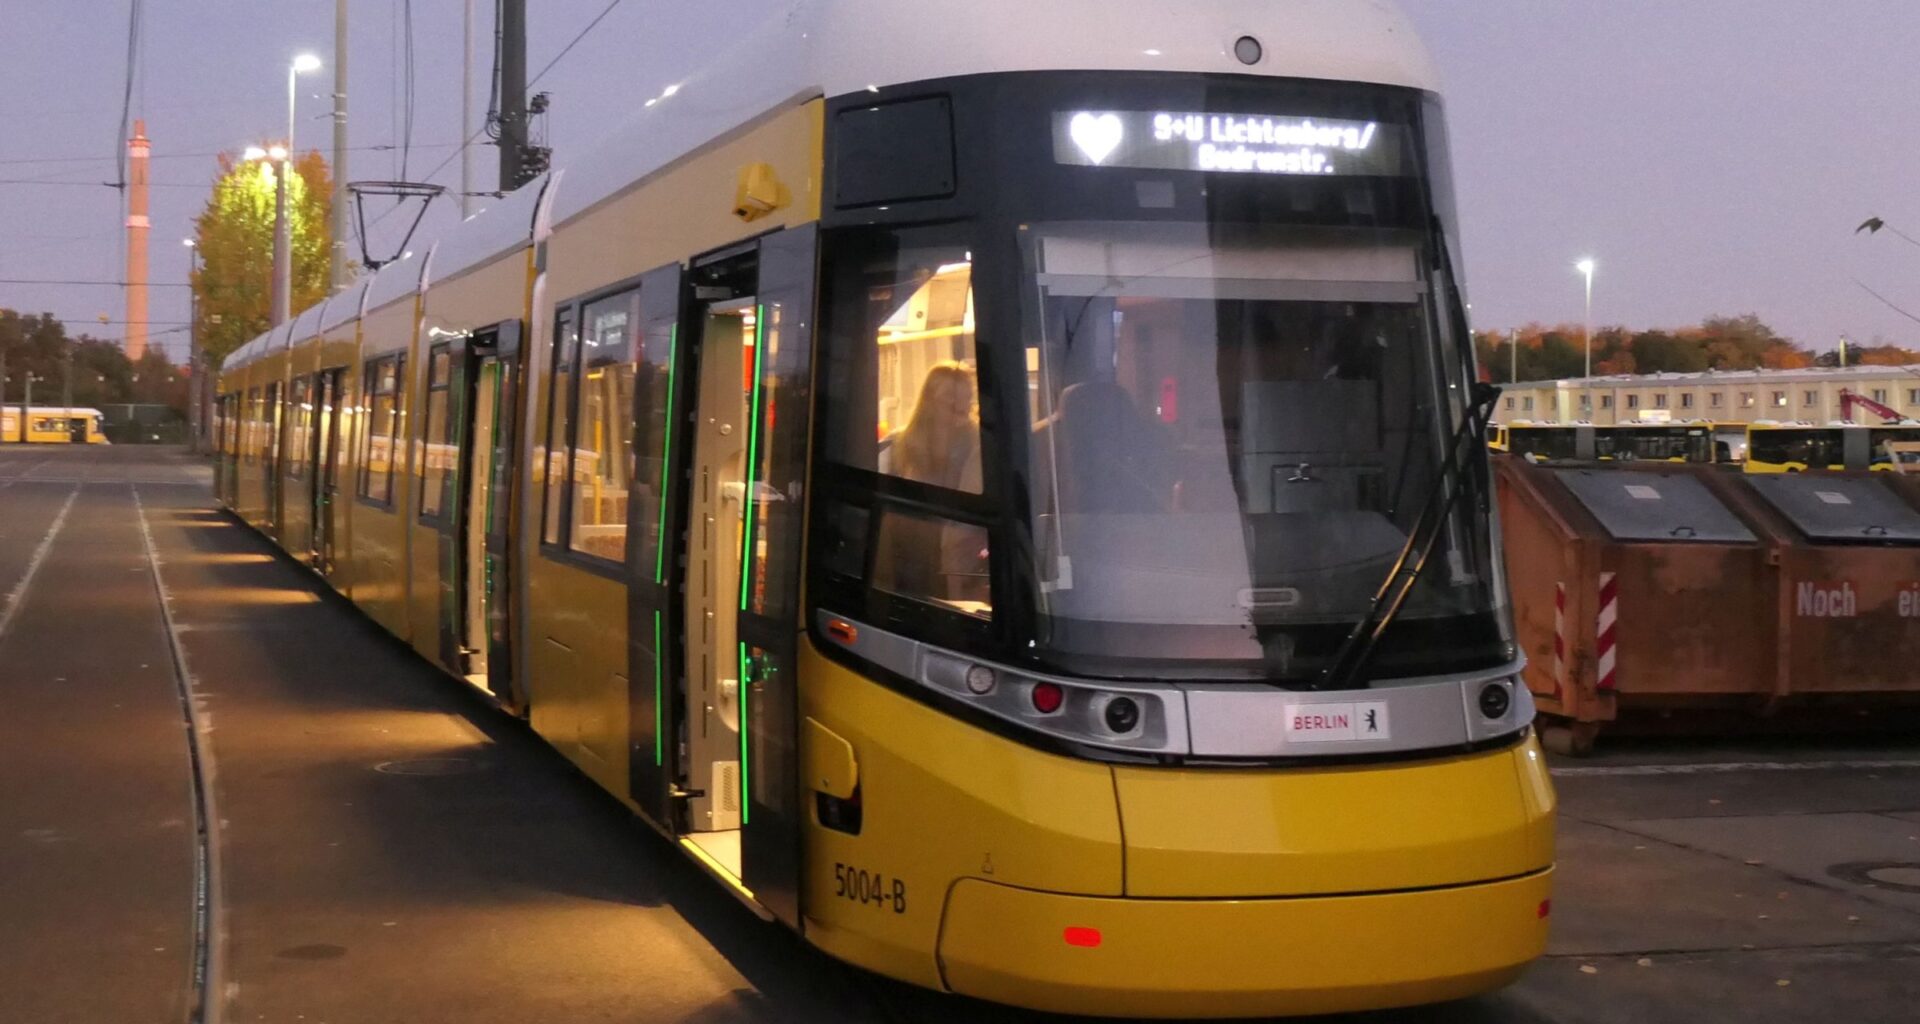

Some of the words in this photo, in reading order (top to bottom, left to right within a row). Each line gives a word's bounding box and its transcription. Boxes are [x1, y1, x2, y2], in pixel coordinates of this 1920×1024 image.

[1154, 112, 1204, 141] S+U
[1797, 581, 1857, 617] Noch
[1898, 582, 1920, 617] ei
[1293, 714, 1349, 730] BERLIN
[835, 862, 906, 914] 5004-B
